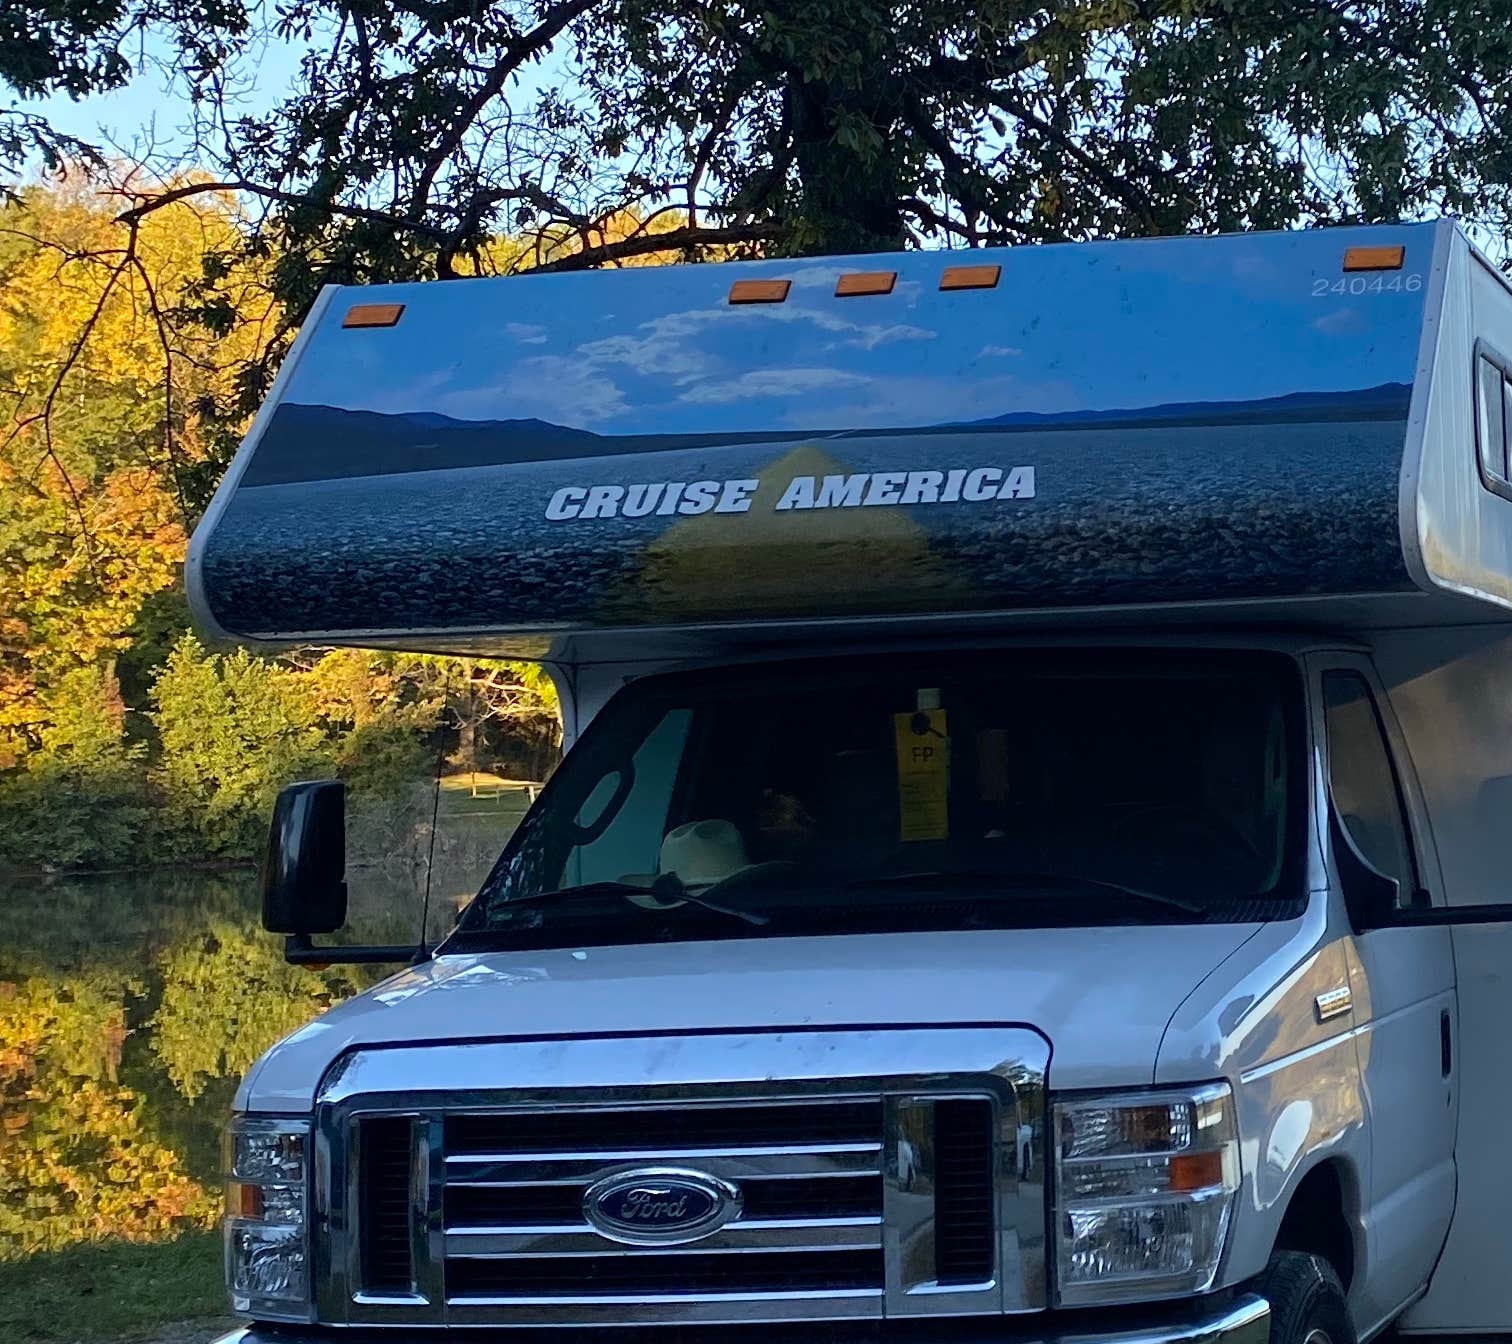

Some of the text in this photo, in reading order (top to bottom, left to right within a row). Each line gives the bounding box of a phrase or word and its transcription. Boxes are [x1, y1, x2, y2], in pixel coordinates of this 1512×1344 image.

[1311, 273, 1422, 297] 240446
[544, 466, 1036, 521] CRUISE AMERICA
[620, 1188, 688, 1218] Ford
